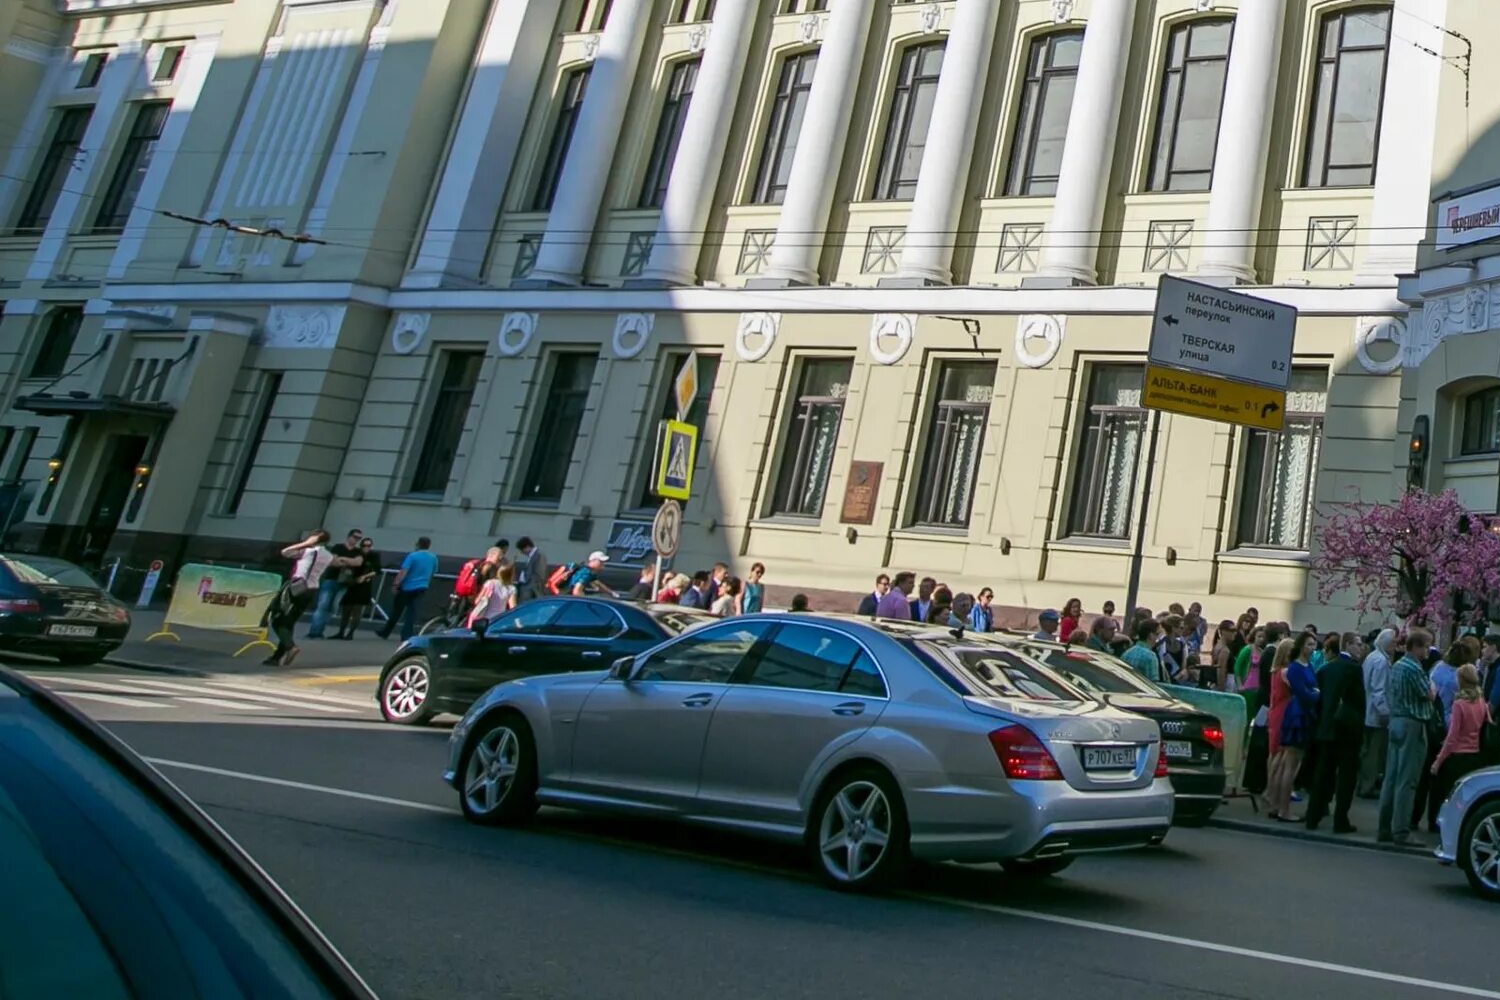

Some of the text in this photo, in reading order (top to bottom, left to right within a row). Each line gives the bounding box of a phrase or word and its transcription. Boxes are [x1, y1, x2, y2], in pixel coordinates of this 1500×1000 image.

[1185, 306, 1231, 325] переулок
[1187, 291, 1275, 321] НАСТАСЬИНСКИЙ
[1182, 333, 1236, 354] ТВЕРСКАЯ
[1179, 348, 1209, 362] улица
[1271, 360, 1285, 371] 0.2
[1151, 377, 1217, 399] АЛЬТА-БАНК
